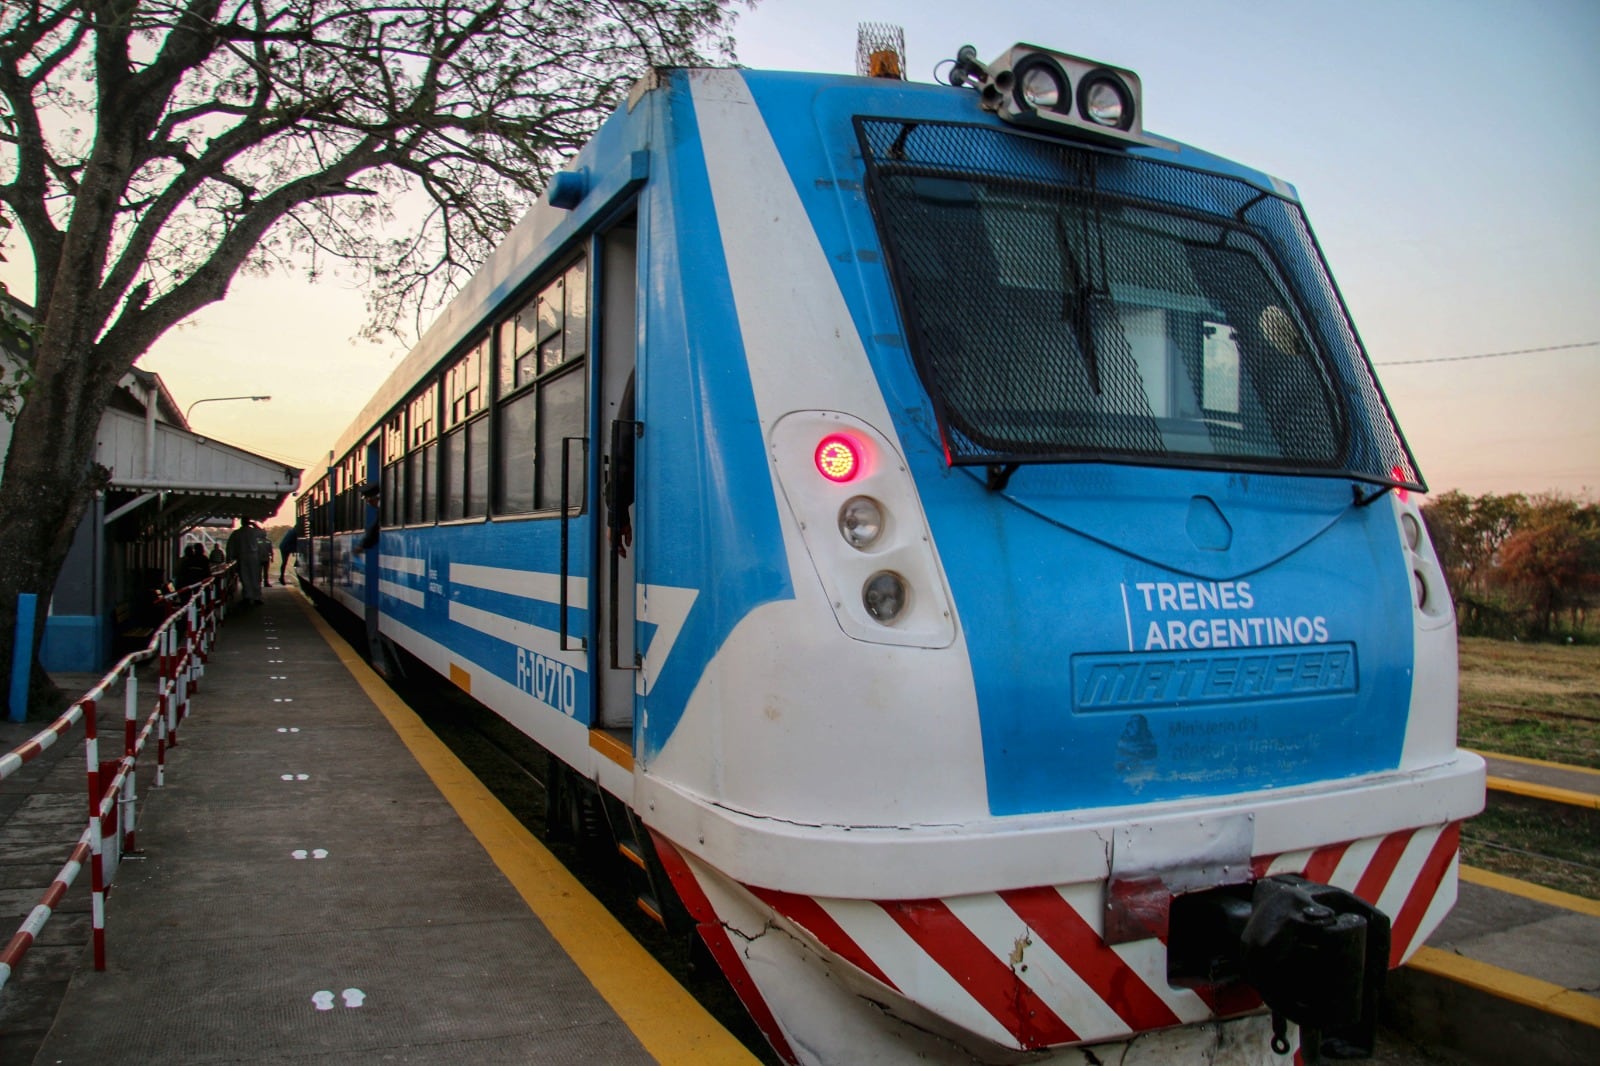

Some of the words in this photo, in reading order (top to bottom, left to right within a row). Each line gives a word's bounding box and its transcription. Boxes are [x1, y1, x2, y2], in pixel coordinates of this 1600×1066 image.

[1136, 581, 1254, 612] TRENES
[1144, 615, 1329, 651] ARGENTINOS
[517, 646, 576, 718] R-10710
[1079, 650, 1352, 706] MATERFER
